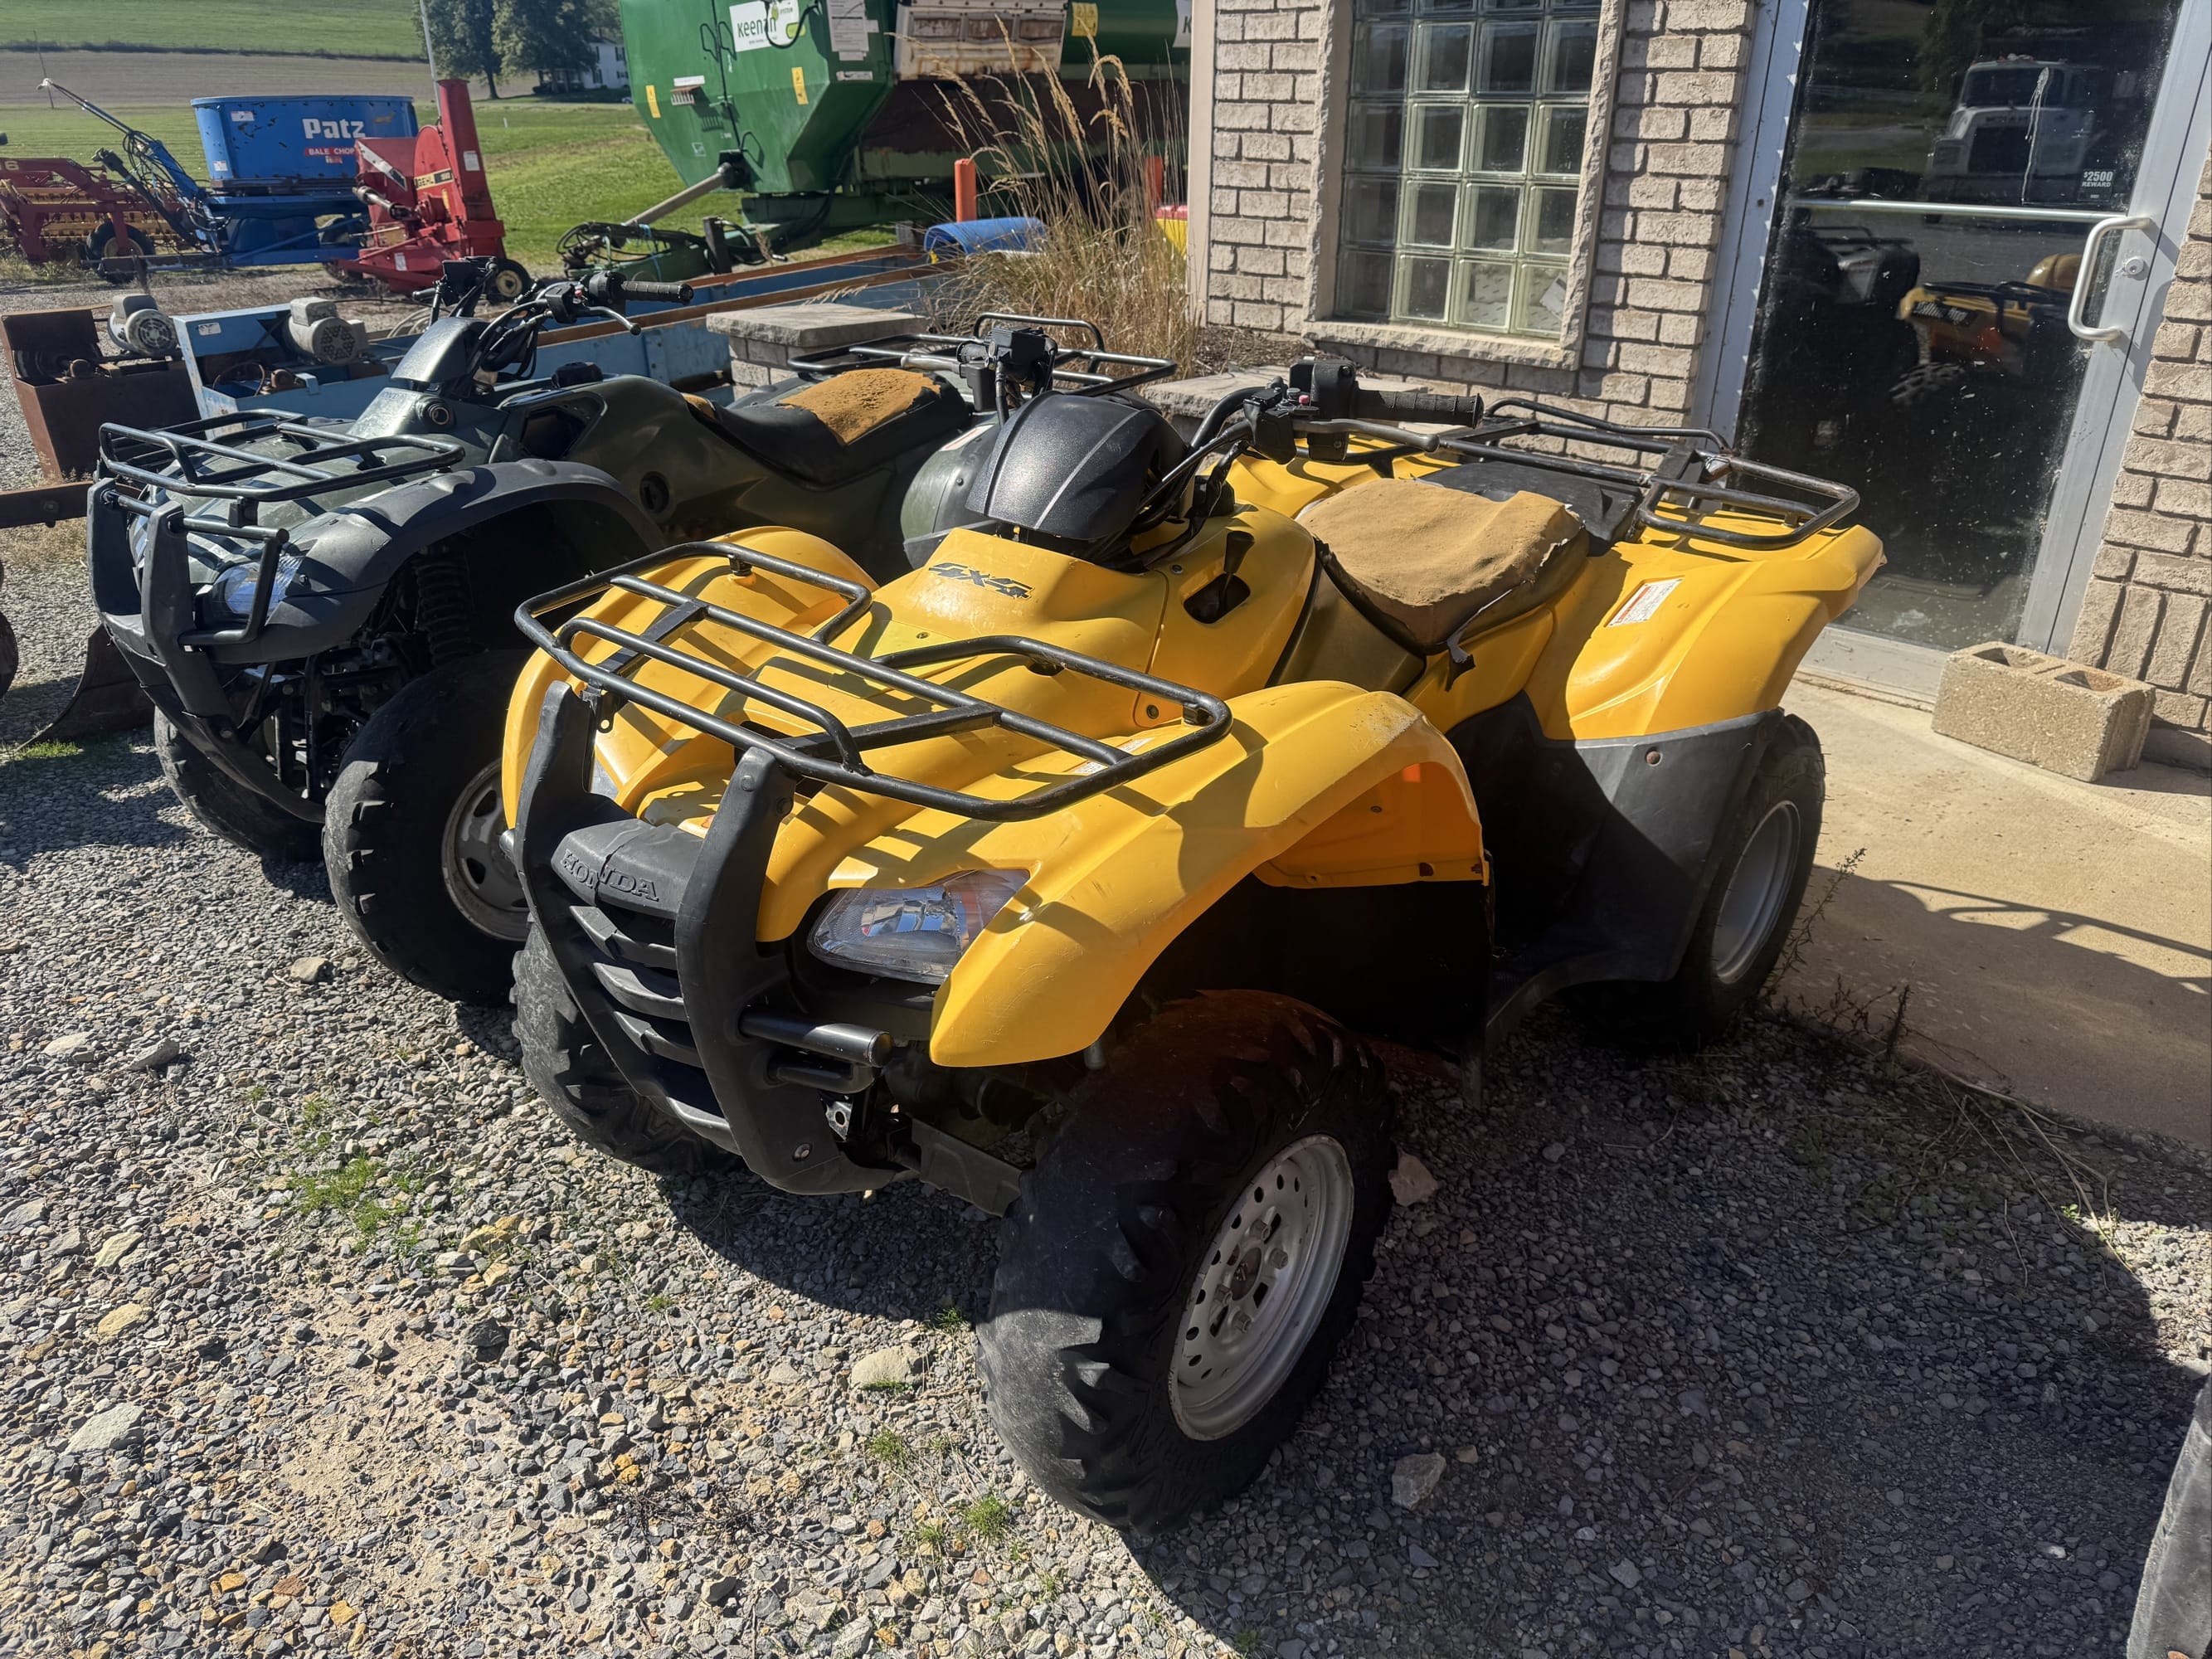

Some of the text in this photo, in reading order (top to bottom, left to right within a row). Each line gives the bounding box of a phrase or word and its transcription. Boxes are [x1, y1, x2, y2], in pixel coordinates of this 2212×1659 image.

[737, 17, 777, 38] Keenn
[302, 118, 367, 139] Patz
[308, 148, 330, 156] BALE
[2083, 171, 2113, 182] $2500
[560, 849, 660, 902] HONDA
